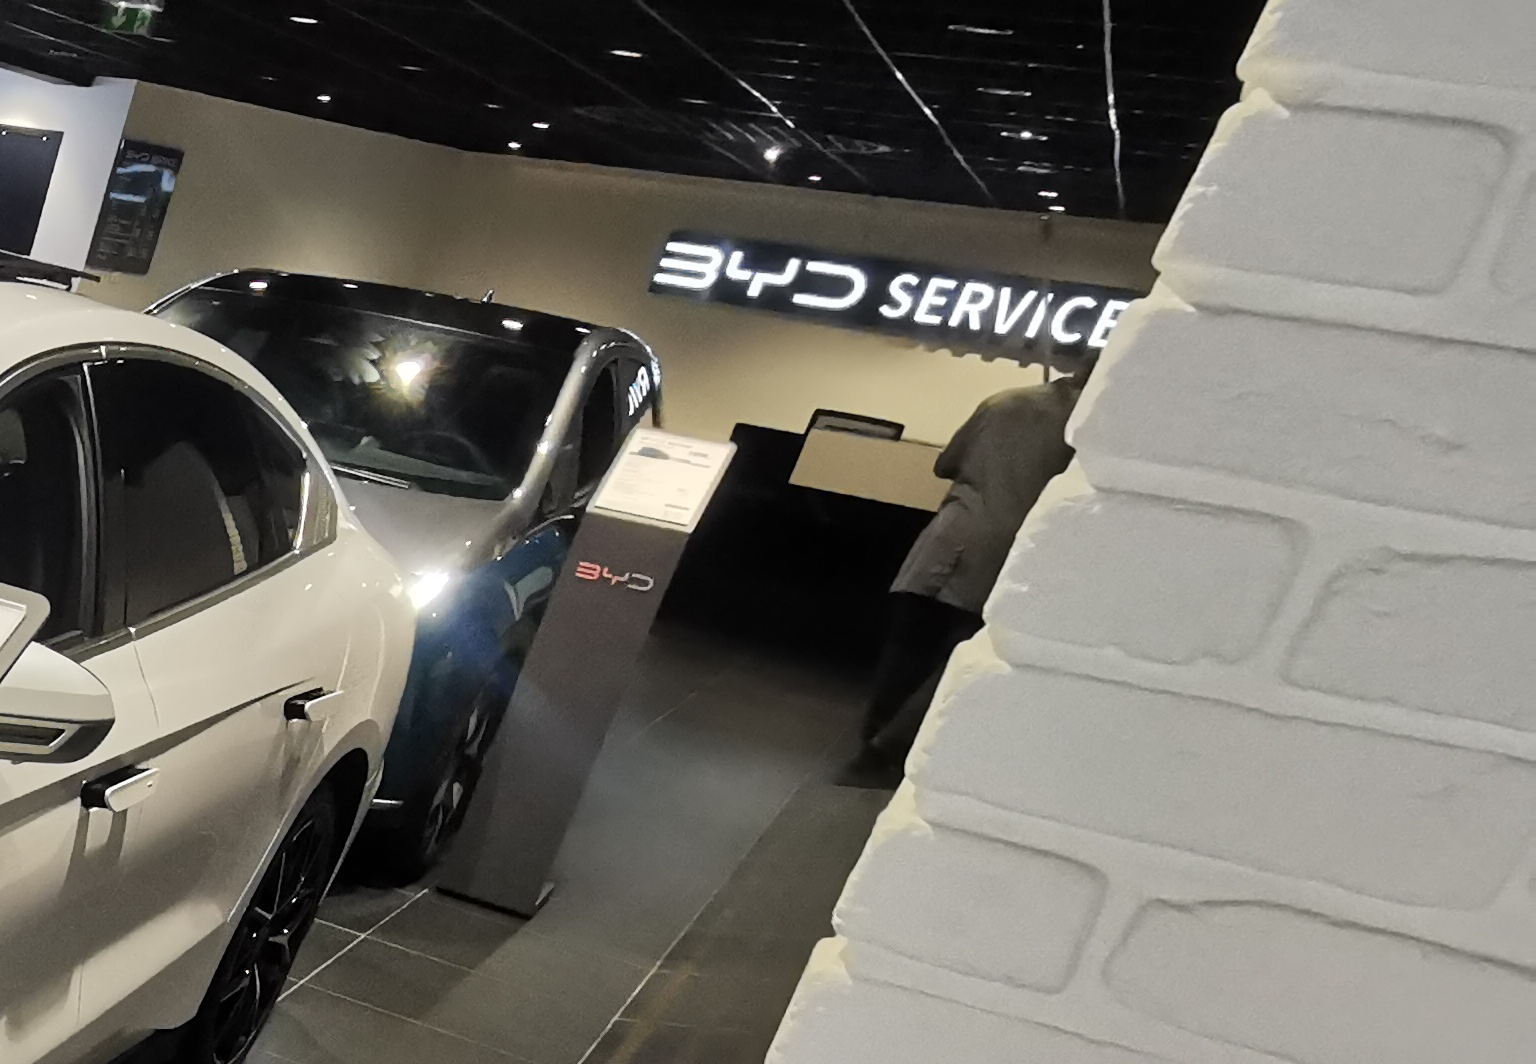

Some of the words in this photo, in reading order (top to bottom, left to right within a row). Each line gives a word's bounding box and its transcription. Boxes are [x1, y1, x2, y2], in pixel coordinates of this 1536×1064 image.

[654, 241, 867, 310] BYD
[878, 274, 1129, 348] SERVICE
[576, 561, 655, 591] BYD
